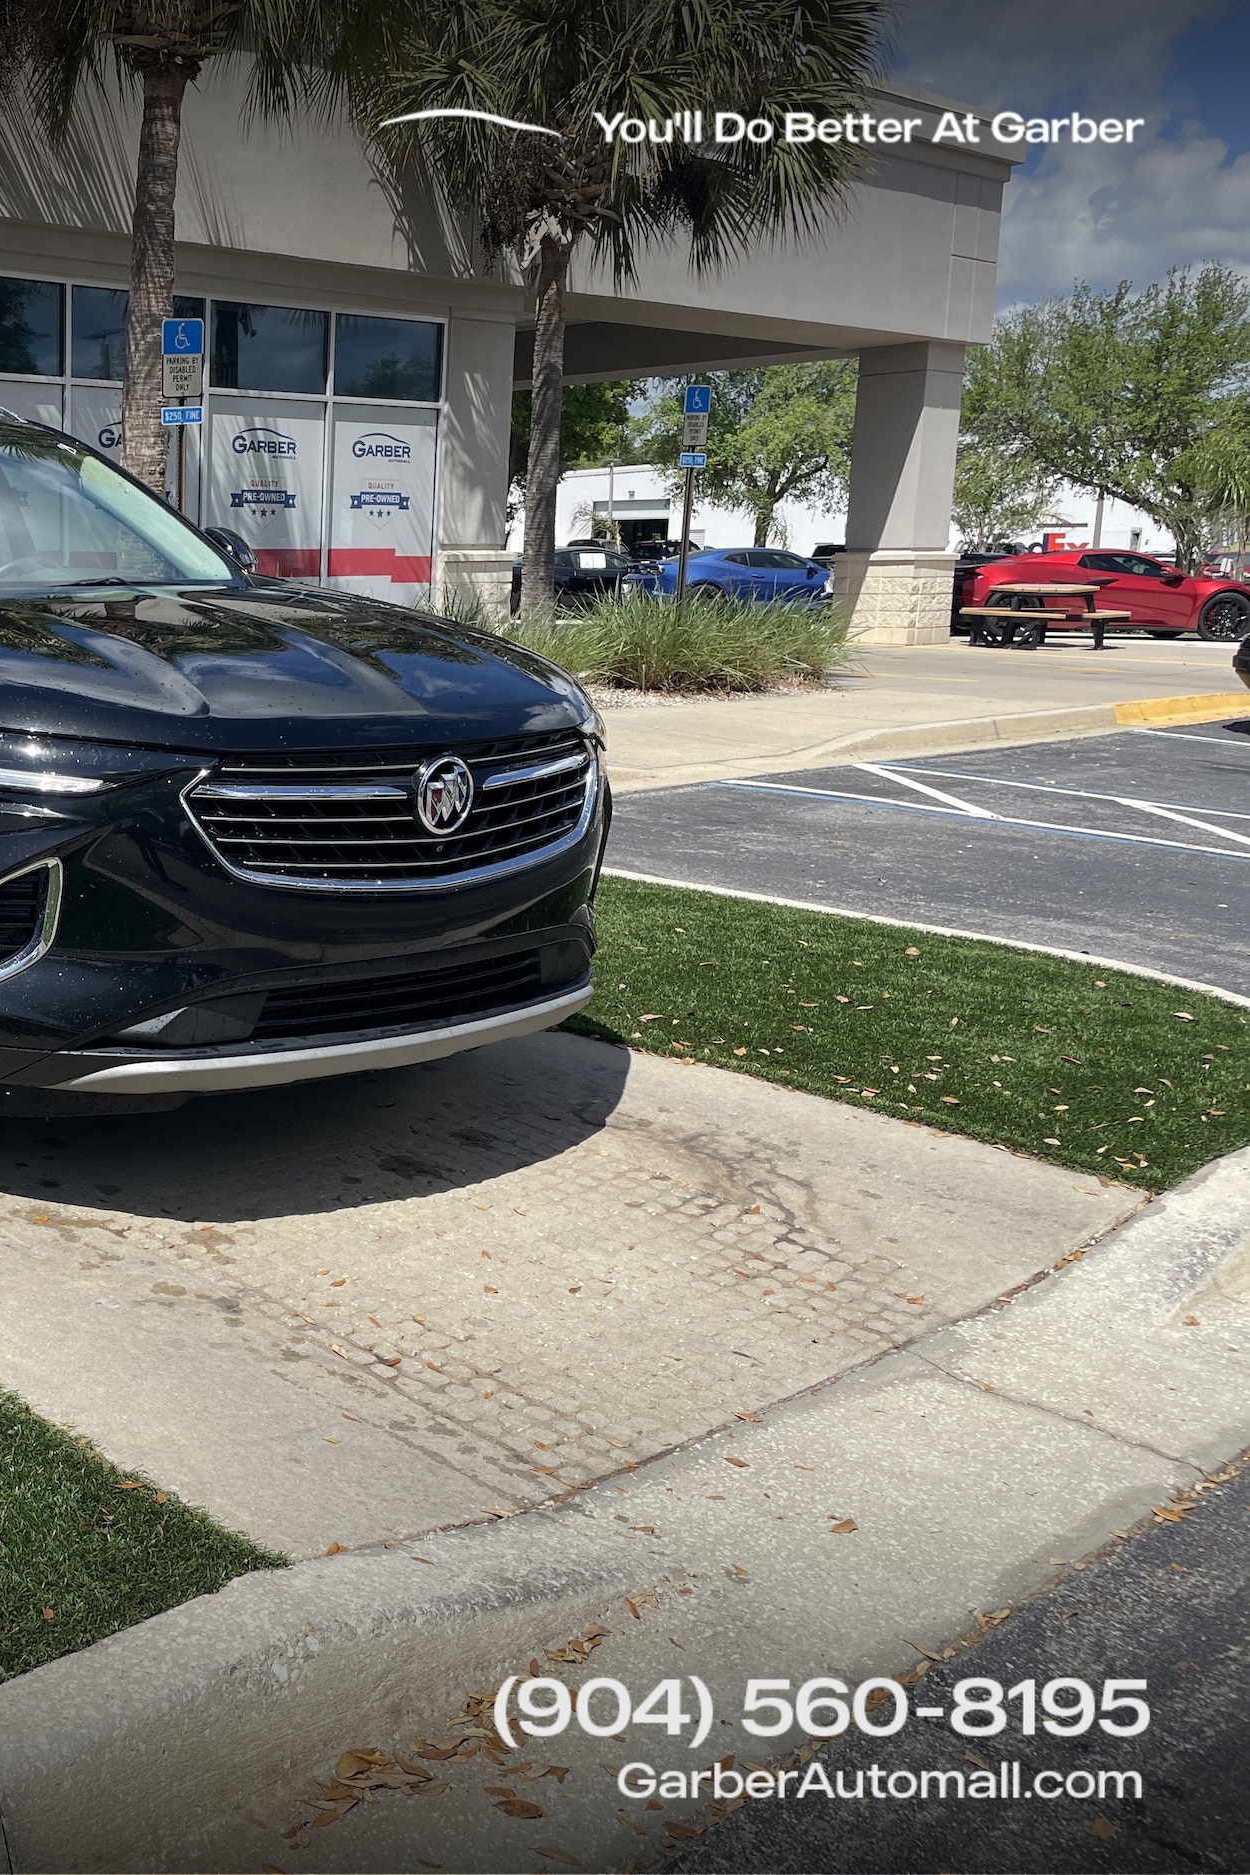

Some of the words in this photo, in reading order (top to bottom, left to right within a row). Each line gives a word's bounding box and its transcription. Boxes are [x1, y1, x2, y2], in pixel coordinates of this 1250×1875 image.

[166, 357, 190, 365] PARKING
[169, 366, 196, 374] DISABLED
[165, 411, 182, 421] $250
[186, 410, 200, 420] FINE
[232, 435, 297, 455] GARBER
[352, 440, 411, 459] GARBER
[250, 479, 279, 487] QUALITY
[368, 482, 394, 490] QUALITY
[242, 492, 286, 502] PRE-OWNED
[361, 494, 400, 504] PRE-OWNED
